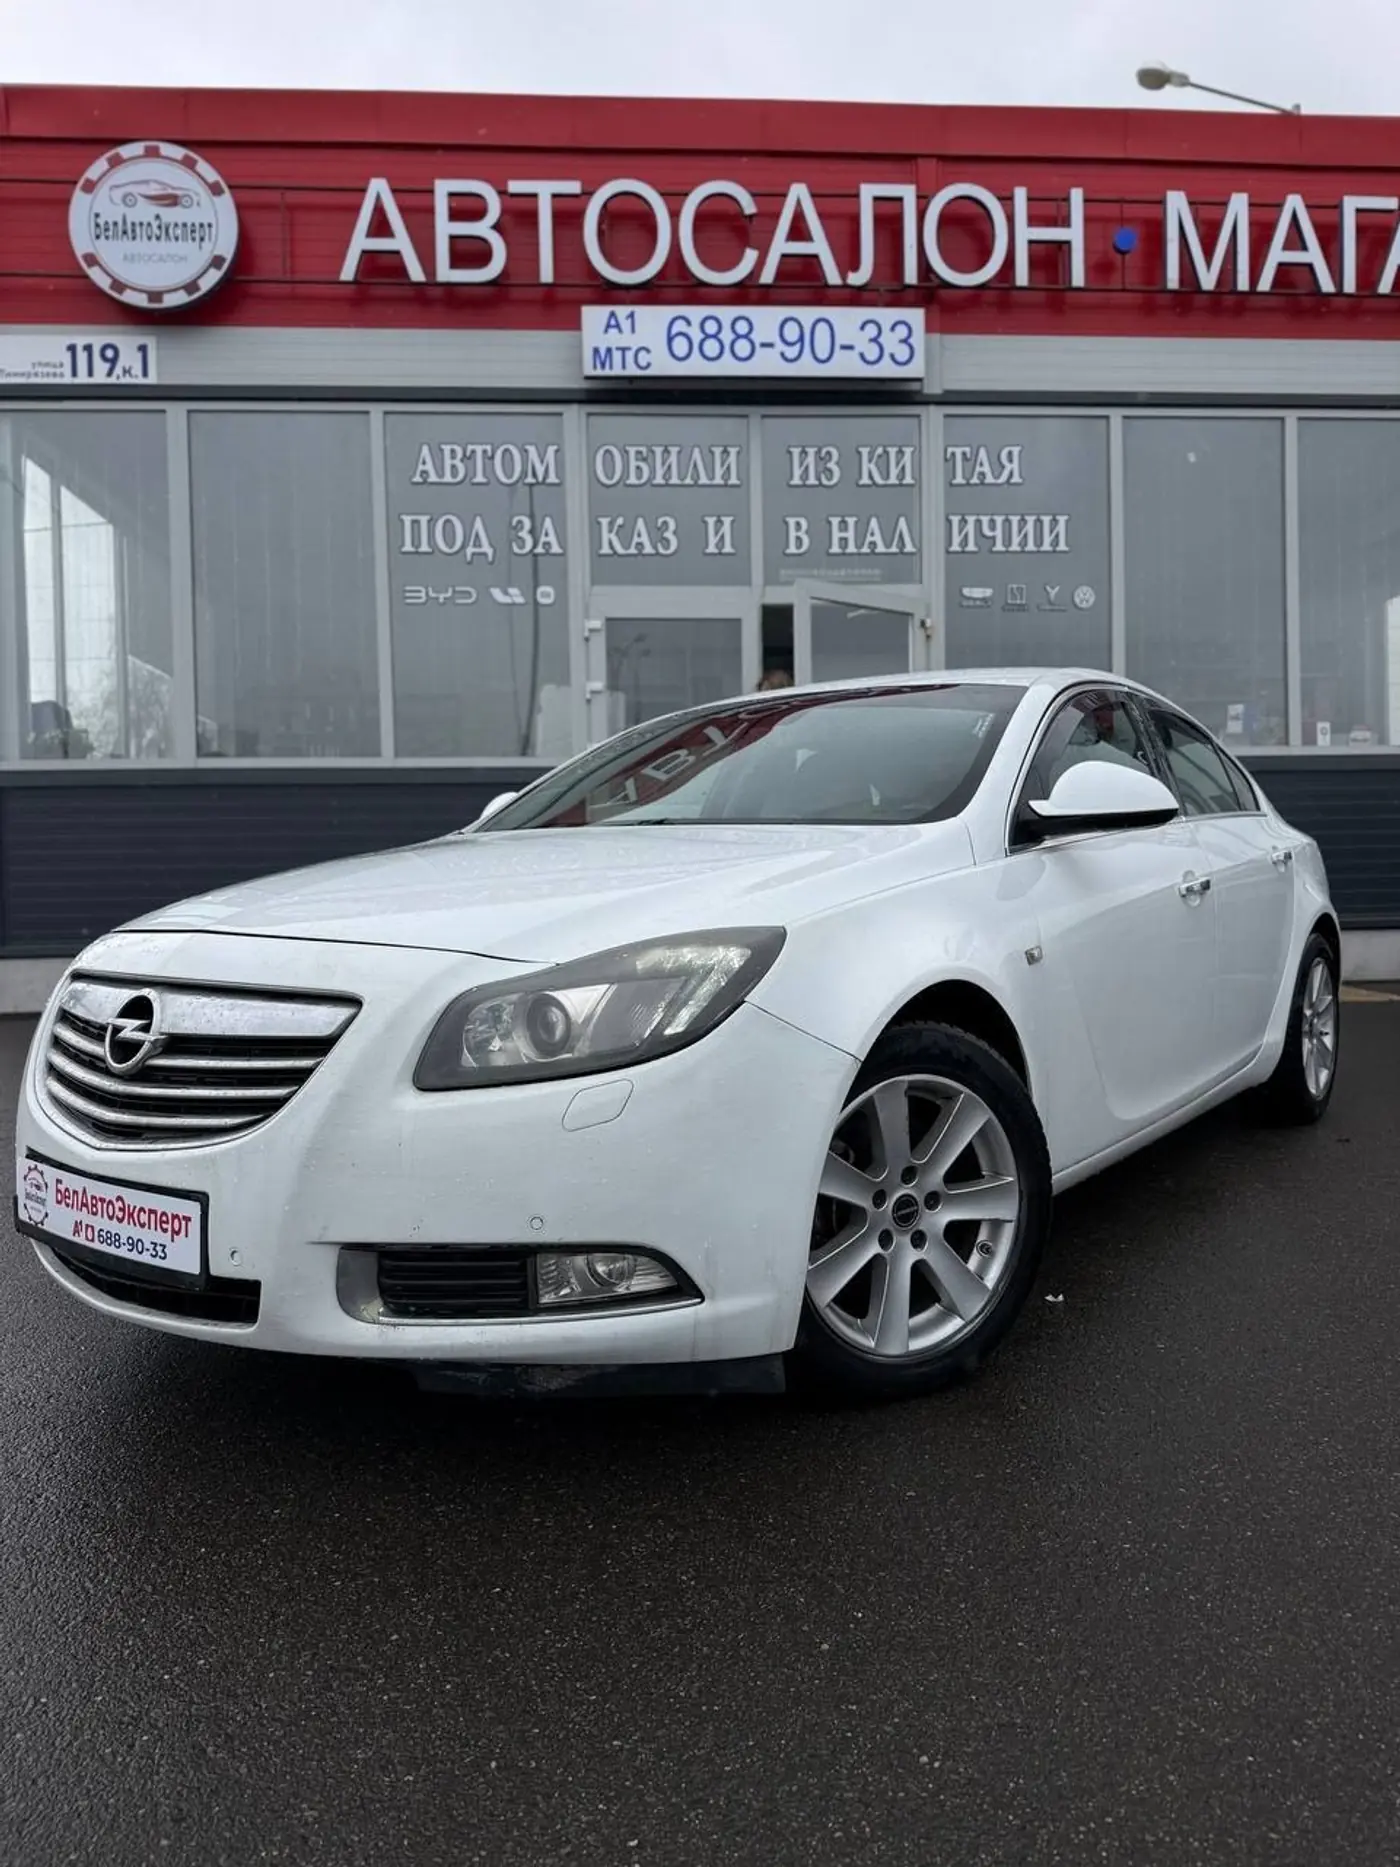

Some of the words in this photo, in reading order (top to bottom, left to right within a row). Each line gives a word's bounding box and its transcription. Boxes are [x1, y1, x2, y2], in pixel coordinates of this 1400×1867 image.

[93, 212, 213, 251] БелАвтоЭксперт
[339, 177, 1085, 288] АВТОСАЛОН
[122, 252, 188, 264] АВТОСАЛОН
[592, 346, 652, 371] МТС
[666, 315, 915, 366] 688-90-33
[411, 444, 560, 485] АВТОМ
[595, 445, 741, 486] ОБИЛИ
[788, 446, 841, 486] ИЗ
[856, 446, 915, 486] КИ
[946, 446, 1023, 485] ТАЯ
[400, 514, 495, 563] ПОД
[511, 515, 564, 555] ЗА
[597, 516, 679, 556] КАЗ
[704, 516, 736, 555] И
[785, 516, 810, 555] В
[828, 516, 917, 554] НАЛ
[948, 514, 1069, 552] ИЧИИ
[404, 585, 477, 604] BYD
[55, 1178, 192, 1242] БелАвтоЭксперт
[97, 1228, 168, 1260] 688-90-33
